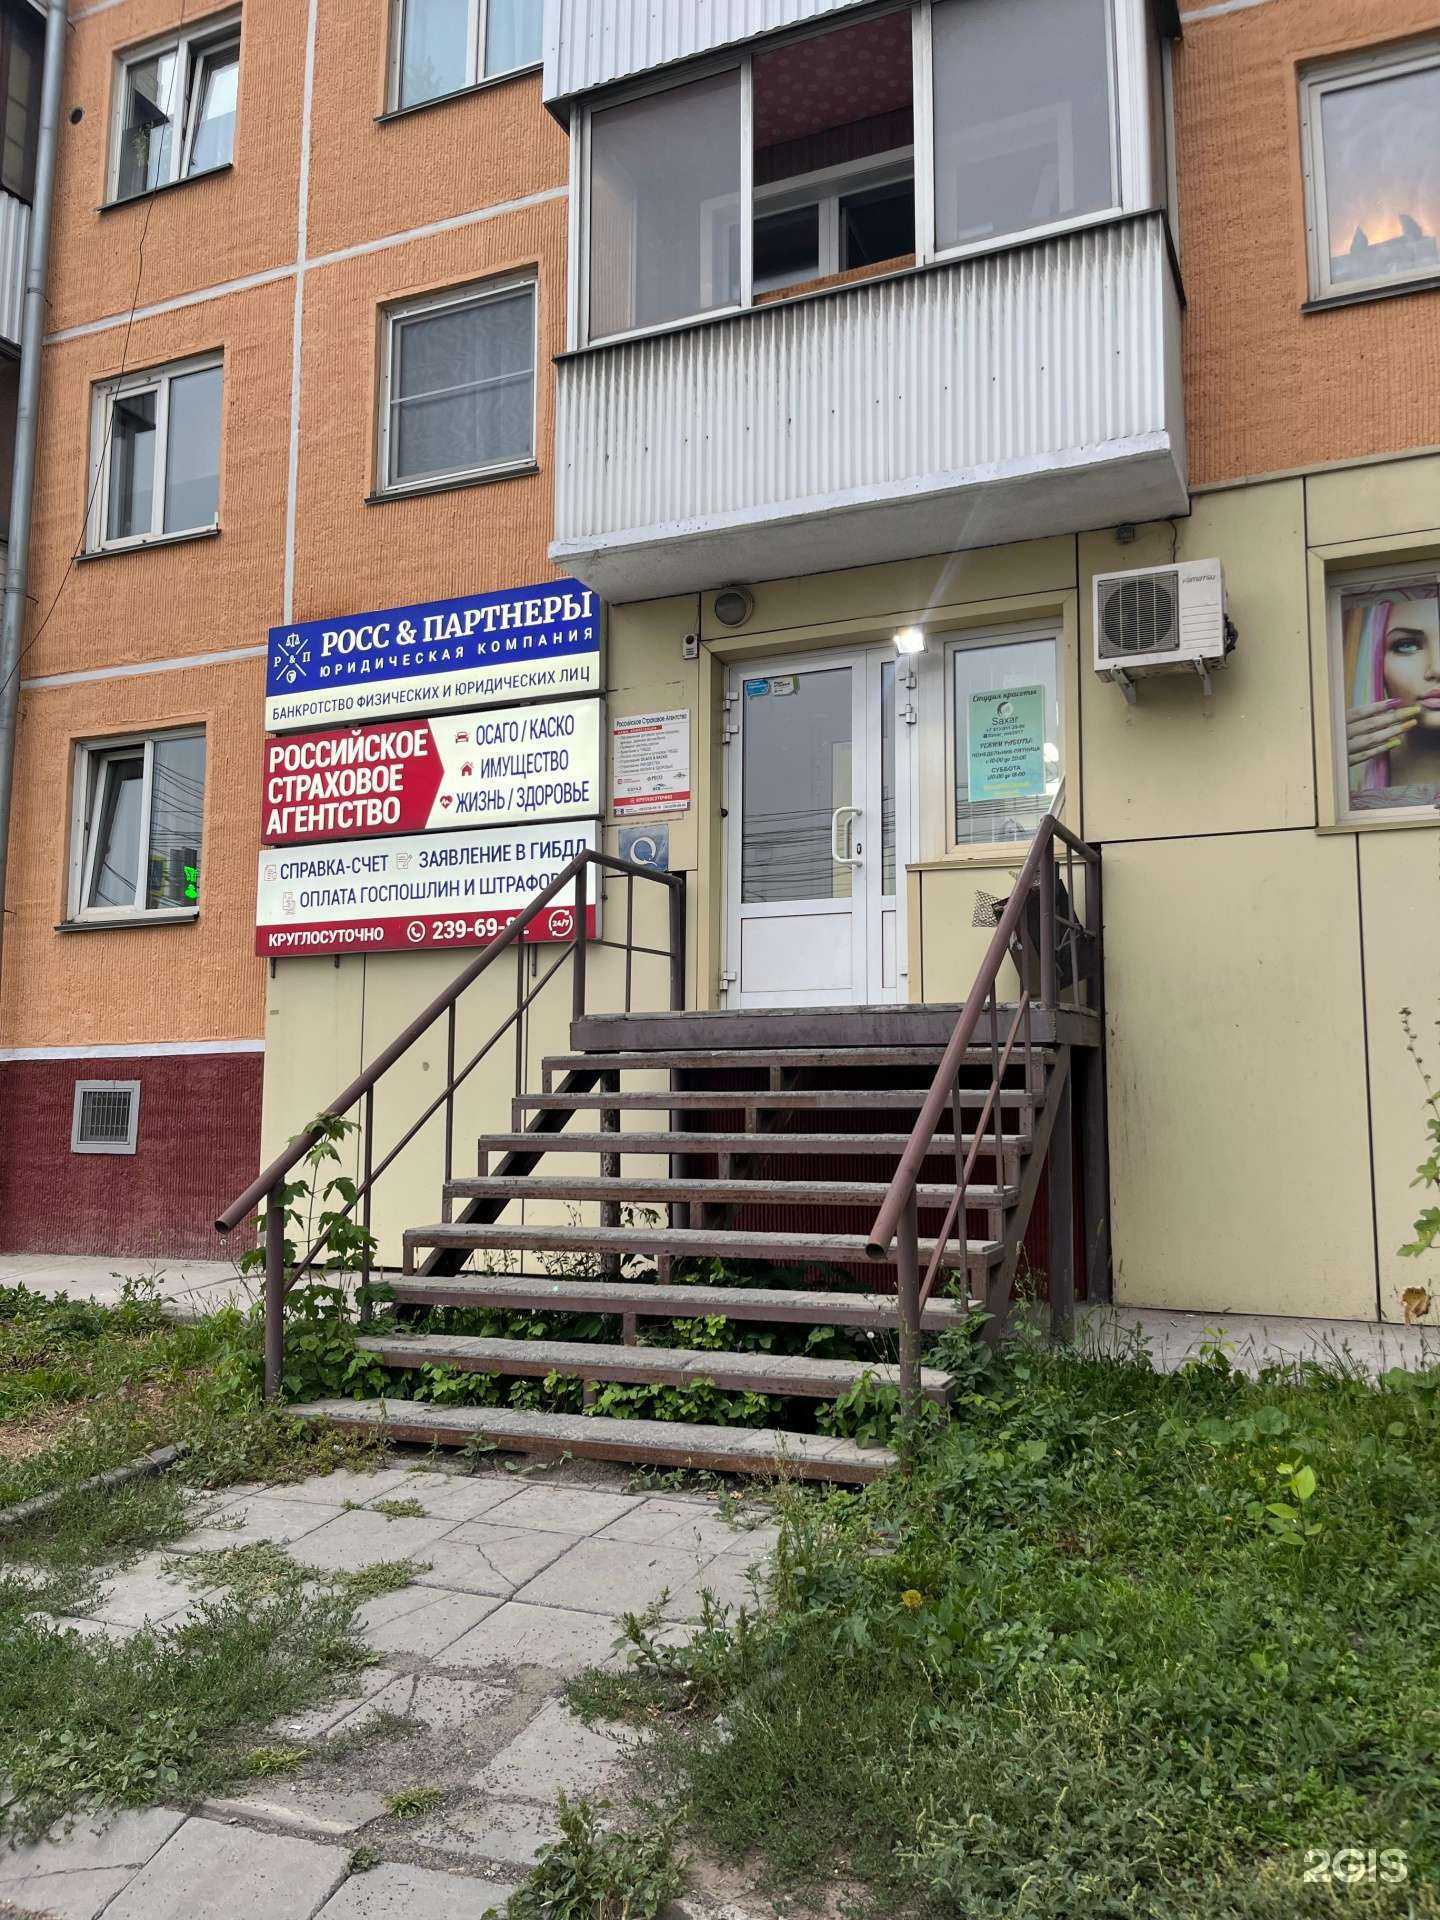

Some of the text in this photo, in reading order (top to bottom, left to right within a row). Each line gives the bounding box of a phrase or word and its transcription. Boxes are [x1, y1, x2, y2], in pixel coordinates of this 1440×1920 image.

[321, 591, 593, 657] РОСС & ПАРТНЕРЫ
[320, 627, 593, 678] ЮРИДИЧЕСКАЯ КОМПАНИЯ
[272, 666, 590, 720] БАНКРОТСТВО ФИЗИЧЕСКИХ И ЮРИДИЧЕСКИХ ЛИЦ
[476, 714, 575, 746] ОСАГО / КАСКО
[269, 729, 428, 773] РОССИЙСКОЕ
[480, 749, 569, 779] ИМУЩЕСТВО
[268, 764, 404, 804] СТРАХОВОЕ
[456, 780, 590, 814] ЖИЗНЬ / ЗДОРОВЬЕ
[266, 797, 401, 835] АГЕНТСТВО
[280, 854, 389, 880] СПРАВКА-СЧЕТ
[419, 844, 512, 868] ЗАЯВЛЕНИЕ
[516, 843, 526, 861] В
[300, 887, 357, 908] ОПЛАТА
[360, 878, 460, 904] ГОСПОШЛИН
[464, 878, 475, 896] И
[268, 927, 385, 947] КРУГЛОСУТОЧНО
[552, 919, 570, 928] 24/7
